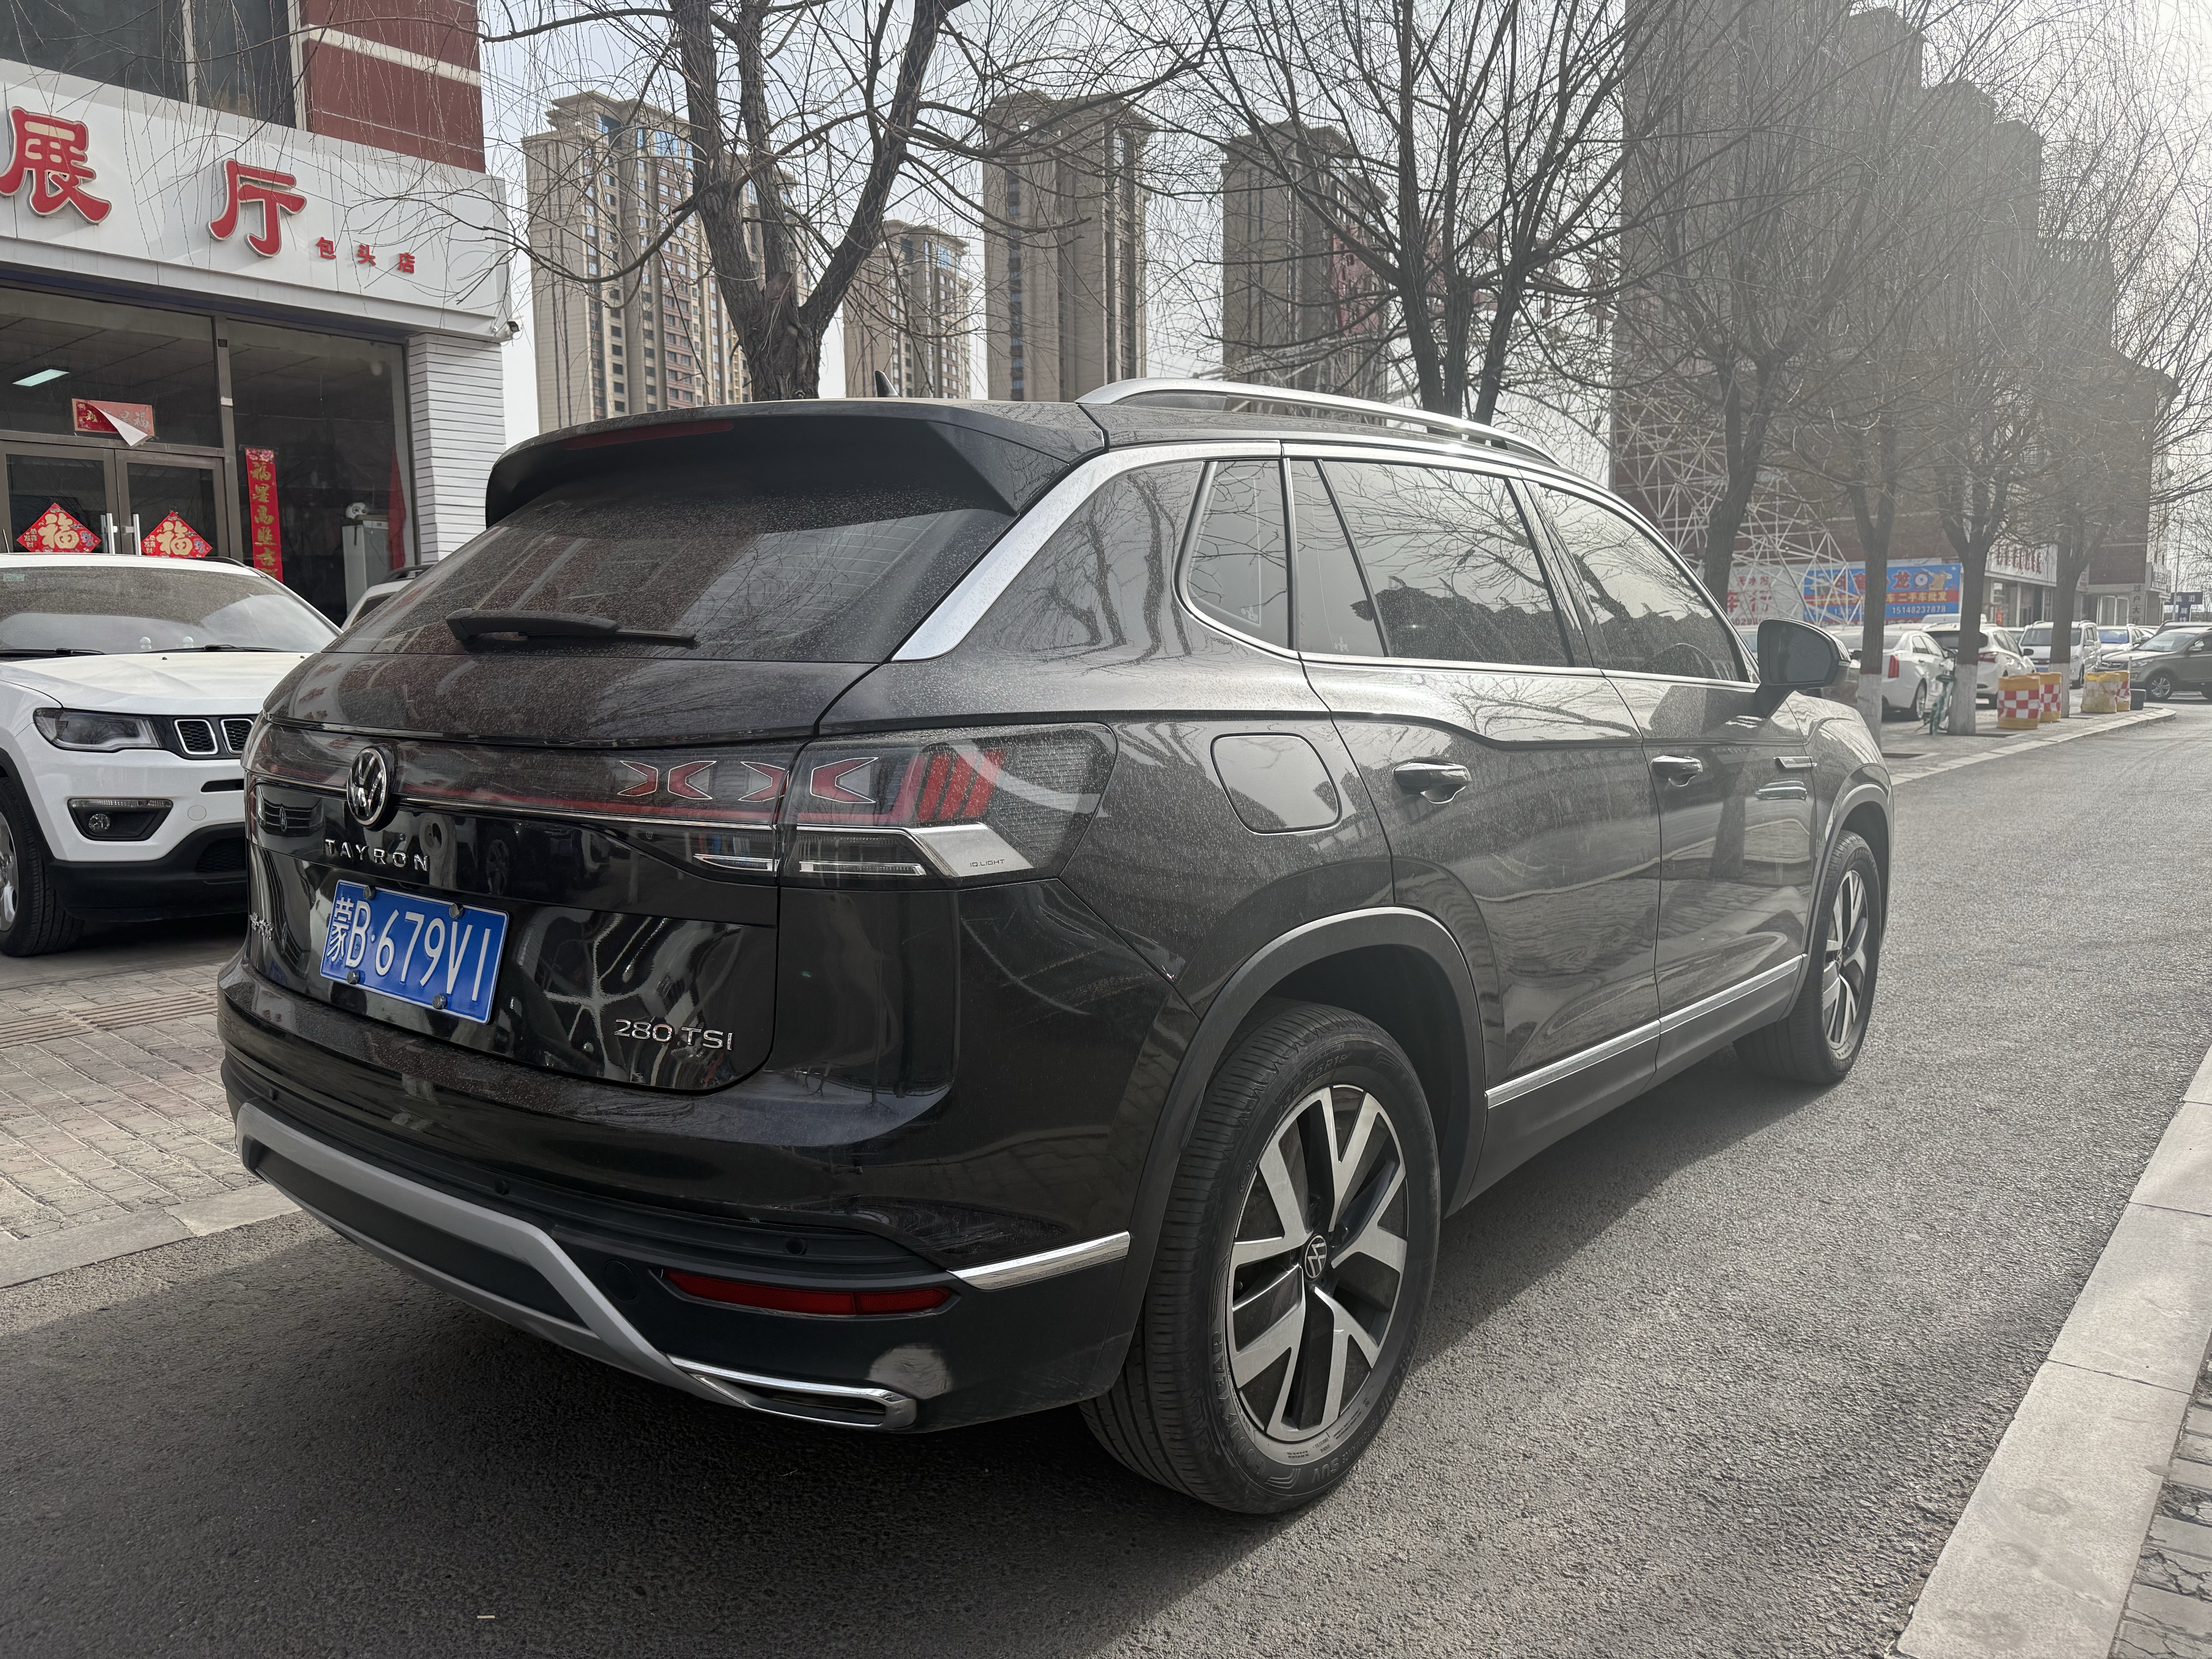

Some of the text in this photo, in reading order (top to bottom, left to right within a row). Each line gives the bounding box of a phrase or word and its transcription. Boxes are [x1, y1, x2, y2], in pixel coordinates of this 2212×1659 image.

[0, 105, 307, 258] 展厅
[316, 236, 416, 274] 包头店
[38, 513, 79, 549] 福
[156, 520, 193, 556] 福
[325, 838, 430, 872] TAYRON
[970, 859, 1005, 867] IQ.LIGHT
[614, 1019, 734, 1051] 280 TSI
[1311, 1457, 1340, 1484] SUV
